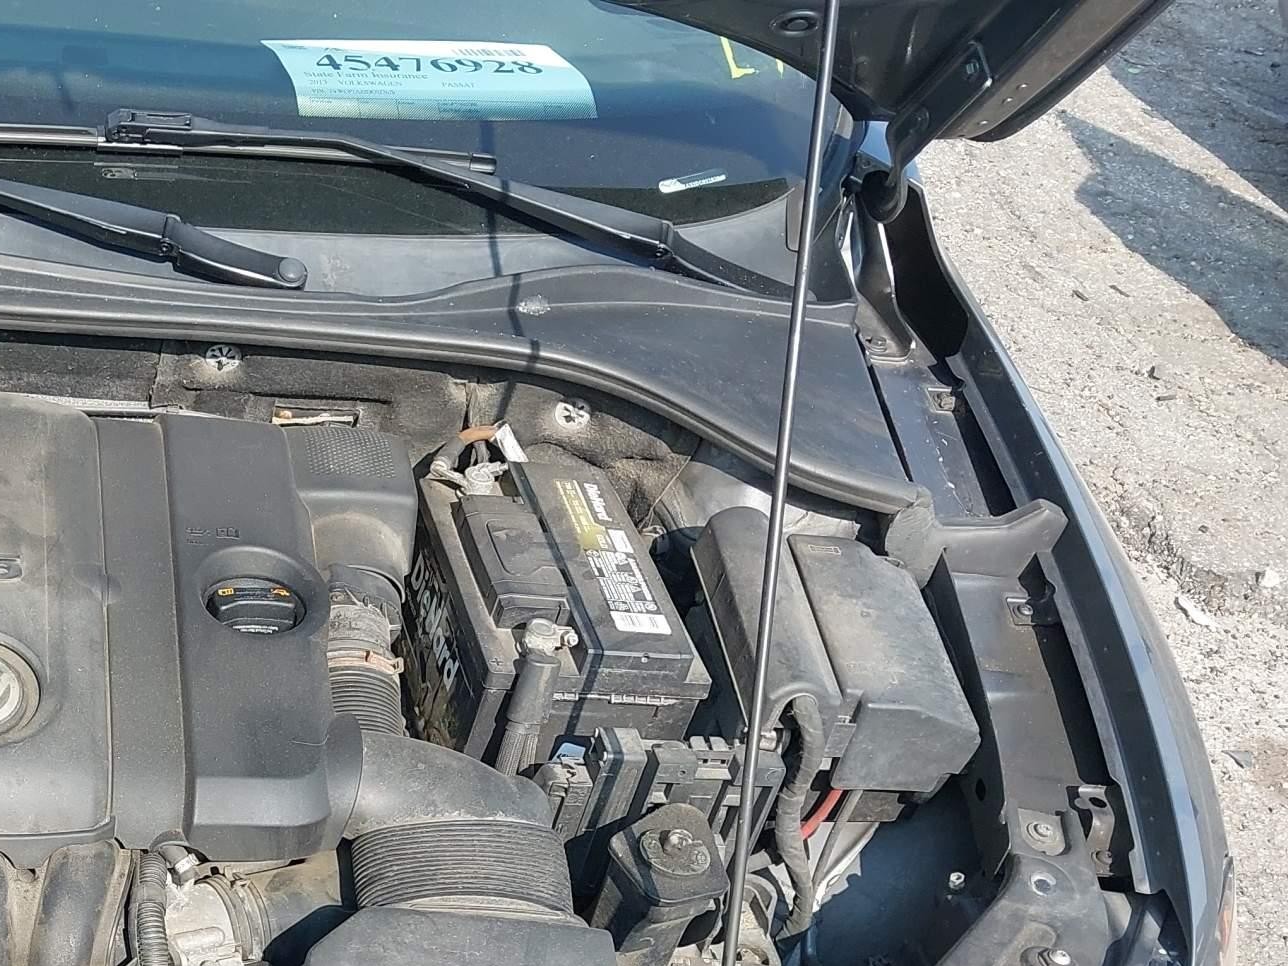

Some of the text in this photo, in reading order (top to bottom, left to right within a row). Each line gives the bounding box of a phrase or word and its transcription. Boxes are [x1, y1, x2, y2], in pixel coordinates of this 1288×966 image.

[304, 71, 335, 79] State
[371, 72, 429, 80] Insurance
[316, 54, 543, 75] 45476928
[583, 482, 612, 522] DieHard
[411, 551, 460, 692] DieHard
